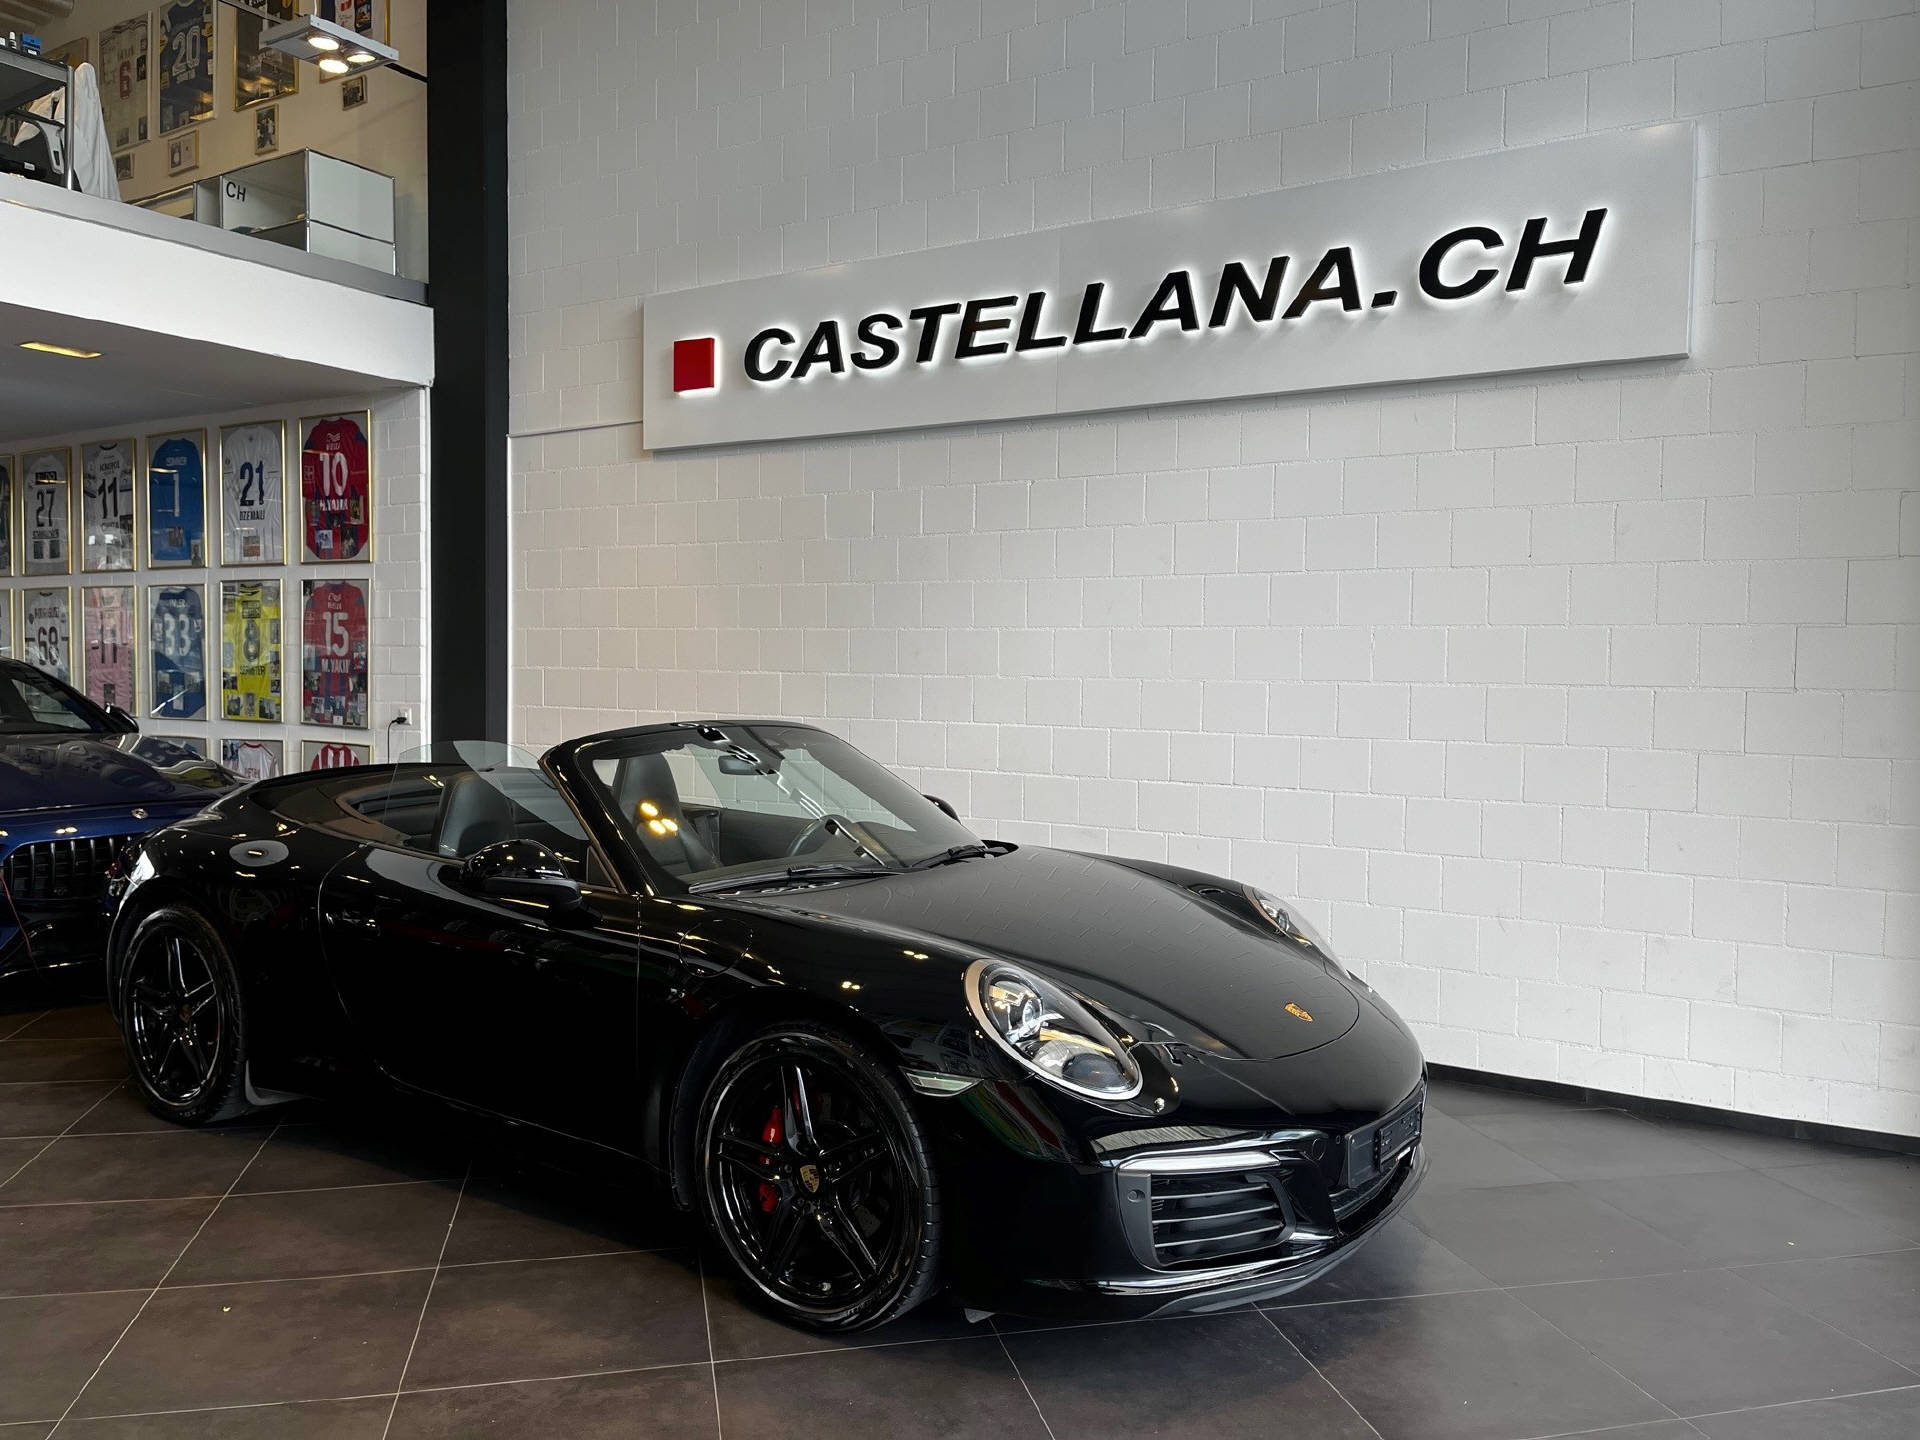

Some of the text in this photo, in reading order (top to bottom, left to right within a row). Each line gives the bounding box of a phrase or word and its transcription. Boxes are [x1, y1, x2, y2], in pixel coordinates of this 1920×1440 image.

[172, 25, 202, 77] 20
[225, 181, 247, 202] CH
[744, 208, 1607, 383] CASTELLANA.CH
[239, 460, 265, 507] 21
[319, 451, 349, 497] 10
[36, 488, 55, 527] 27
[97, 477, 119, 519] 11
[163, 612, 192, 657] 33
[243, 620, 261, 662] 8
[322, 611, 350, 657] 15
